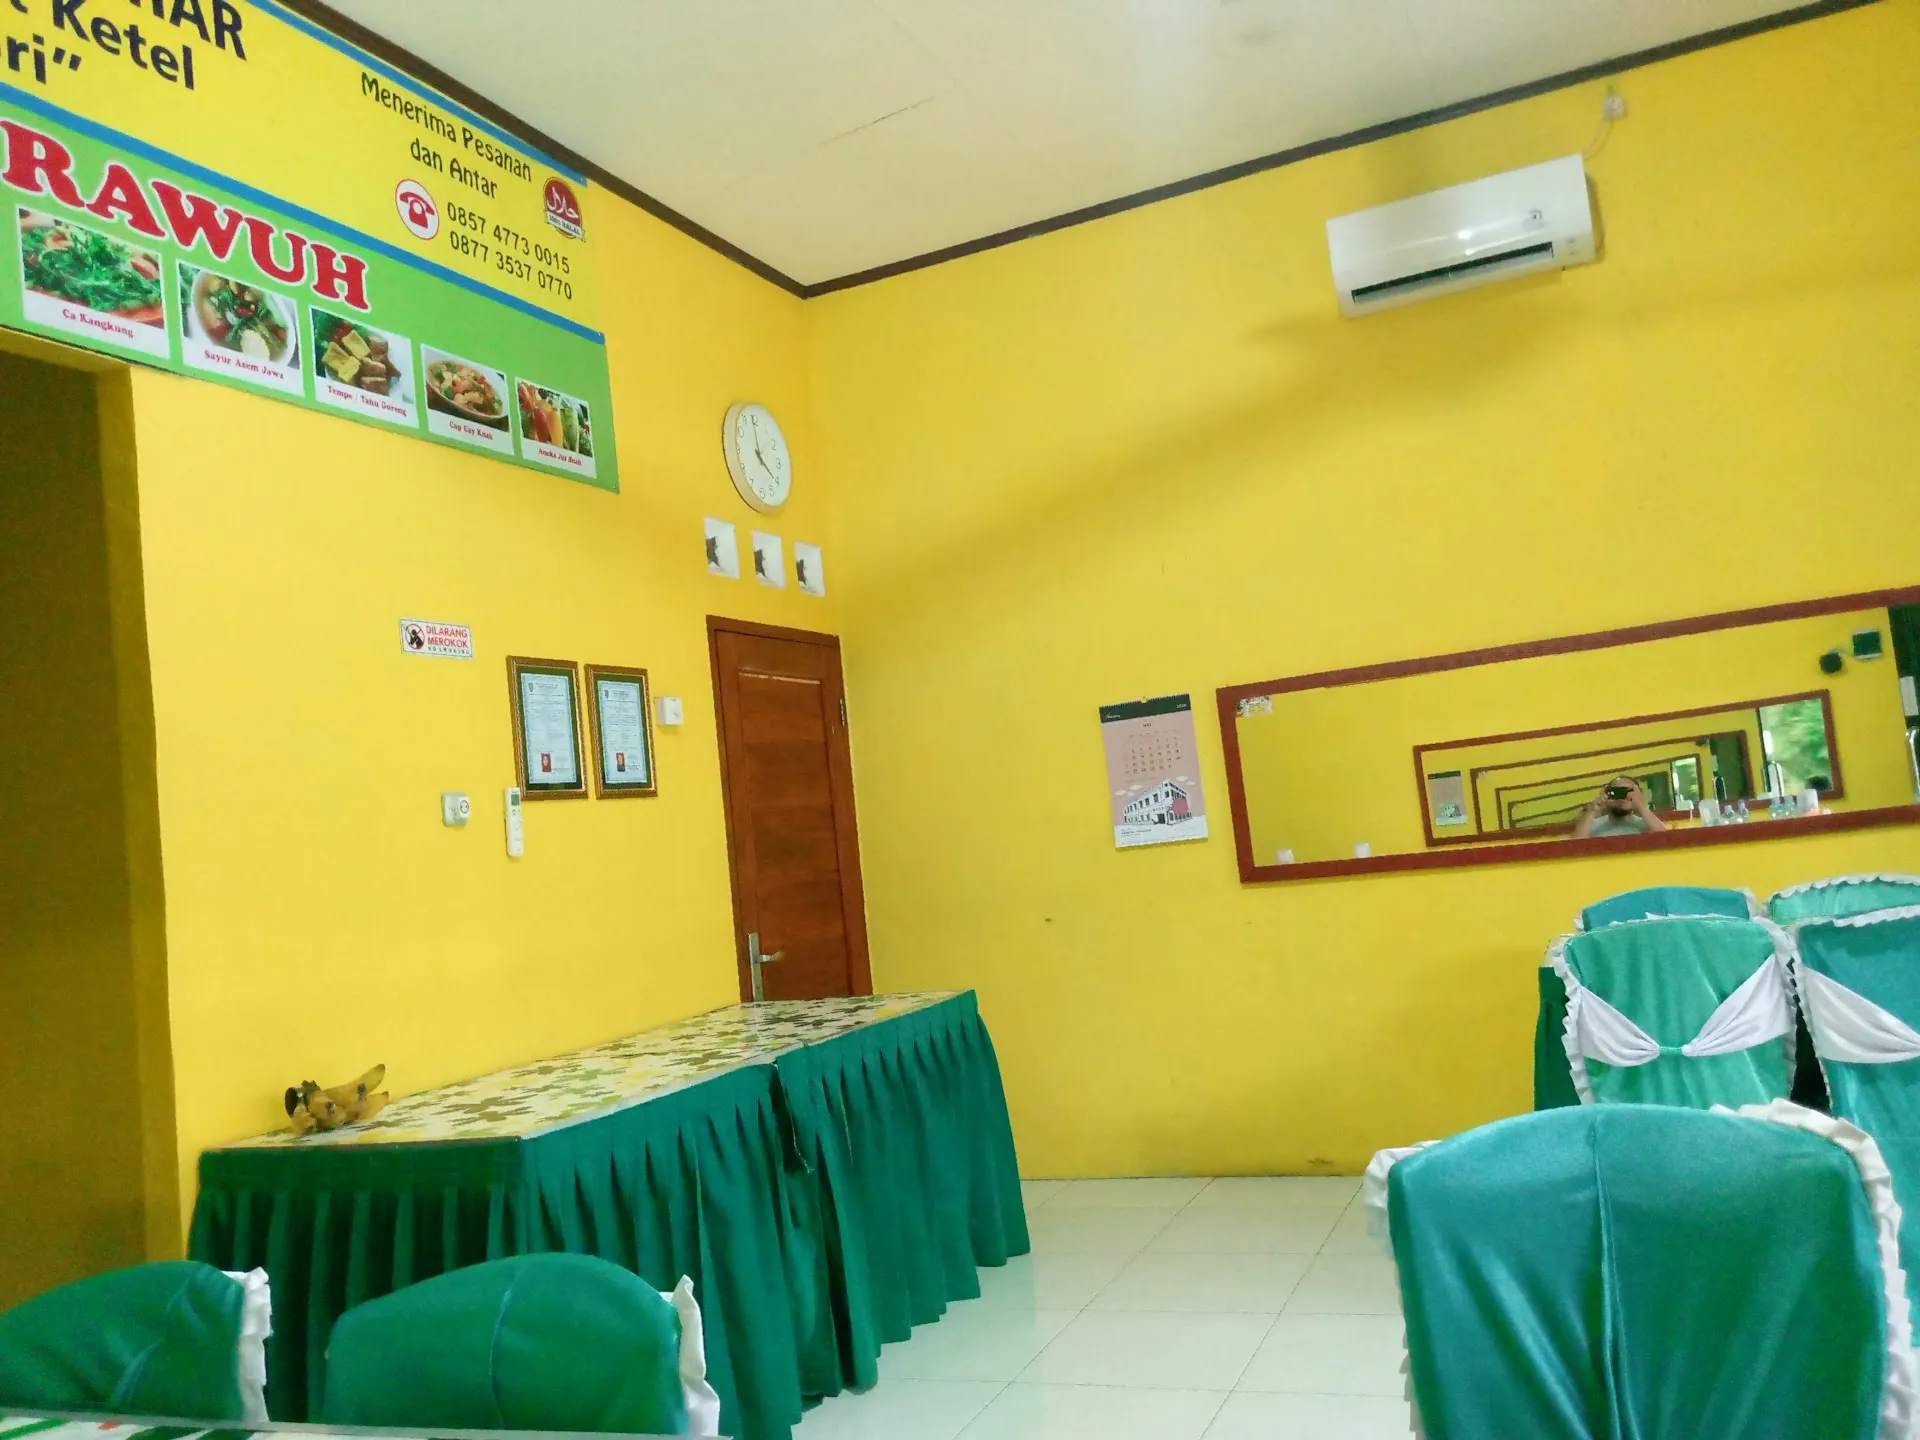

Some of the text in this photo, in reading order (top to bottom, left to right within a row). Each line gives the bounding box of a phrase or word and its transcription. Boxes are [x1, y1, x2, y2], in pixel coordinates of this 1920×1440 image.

[0, 33, 82, 85] ri"
[52, 0, 195, 90] Ketel
[129, 0, 247, 61] AR
[361, 72, 532, 183] Menerima Pesanan
[410, 138, 498, 199] dan Antar
[0, 120, 369, 310] RAWUH
[447, 202, 570, 275] 0857 4773 0015
[450, 232, 572, 300] 0877 3537 0770
[62, 308, 134, 338] Ca Kangkung
[204, 349, 284, 379] Sayur Asem Jawa
[327, 385, 353, 400] Tempe
[381, 400, 407, 417] Goreng
[426, 625, 468, 638] DILARANG
[427, 636, 468, 649] MEROKOK
